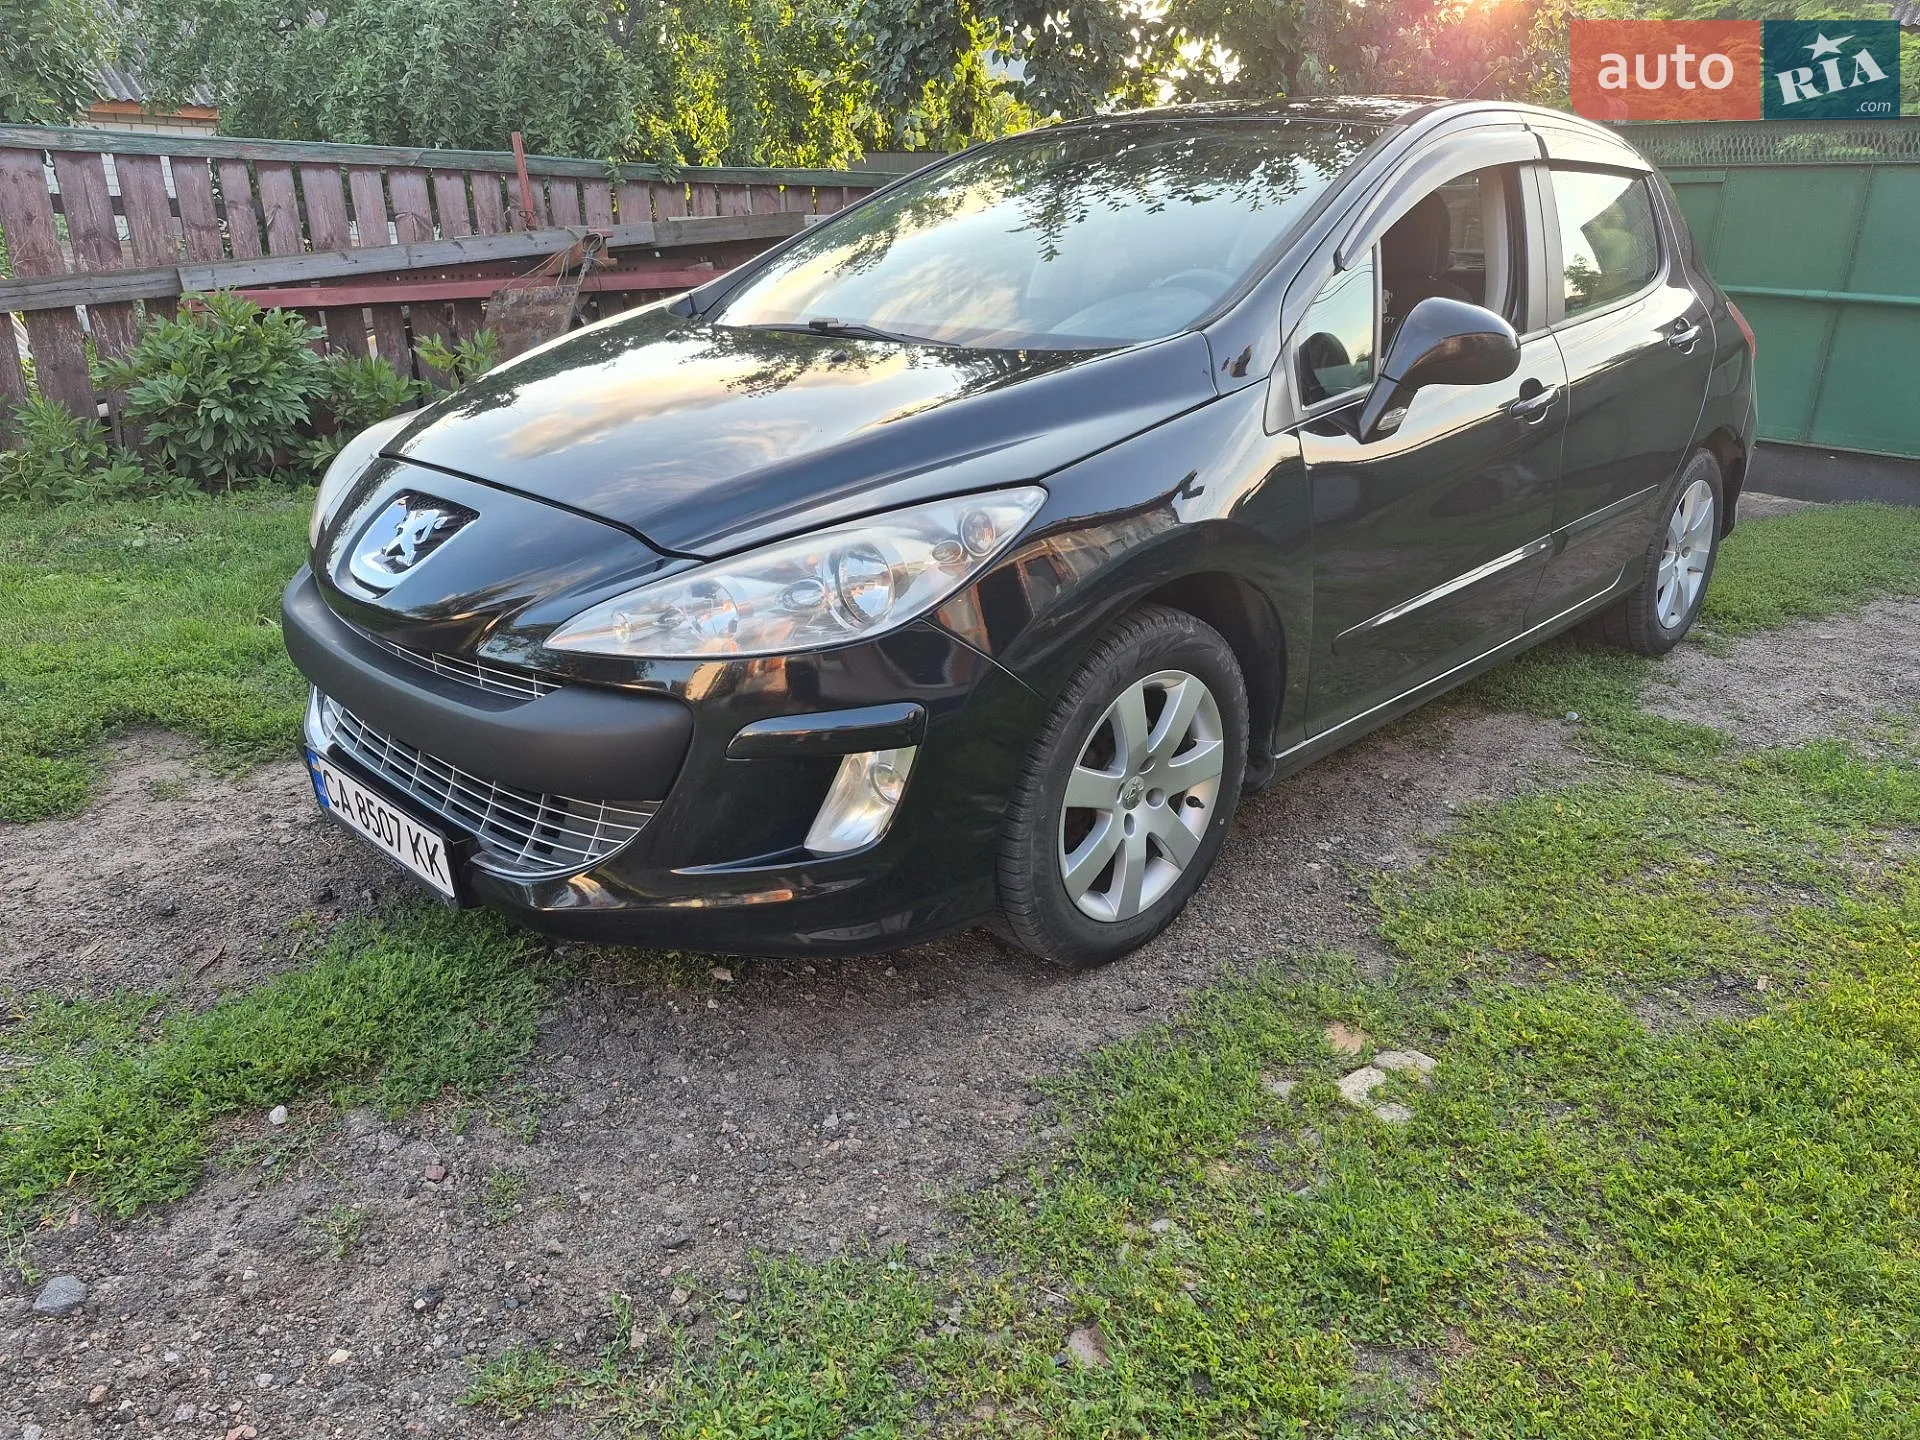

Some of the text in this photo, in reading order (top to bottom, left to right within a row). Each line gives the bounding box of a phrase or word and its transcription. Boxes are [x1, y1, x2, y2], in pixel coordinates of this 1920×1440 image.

[323, 769, 356, 821] CA
[354, 790, 401, 852] 8507
[406, 824, 448, 885] KK
